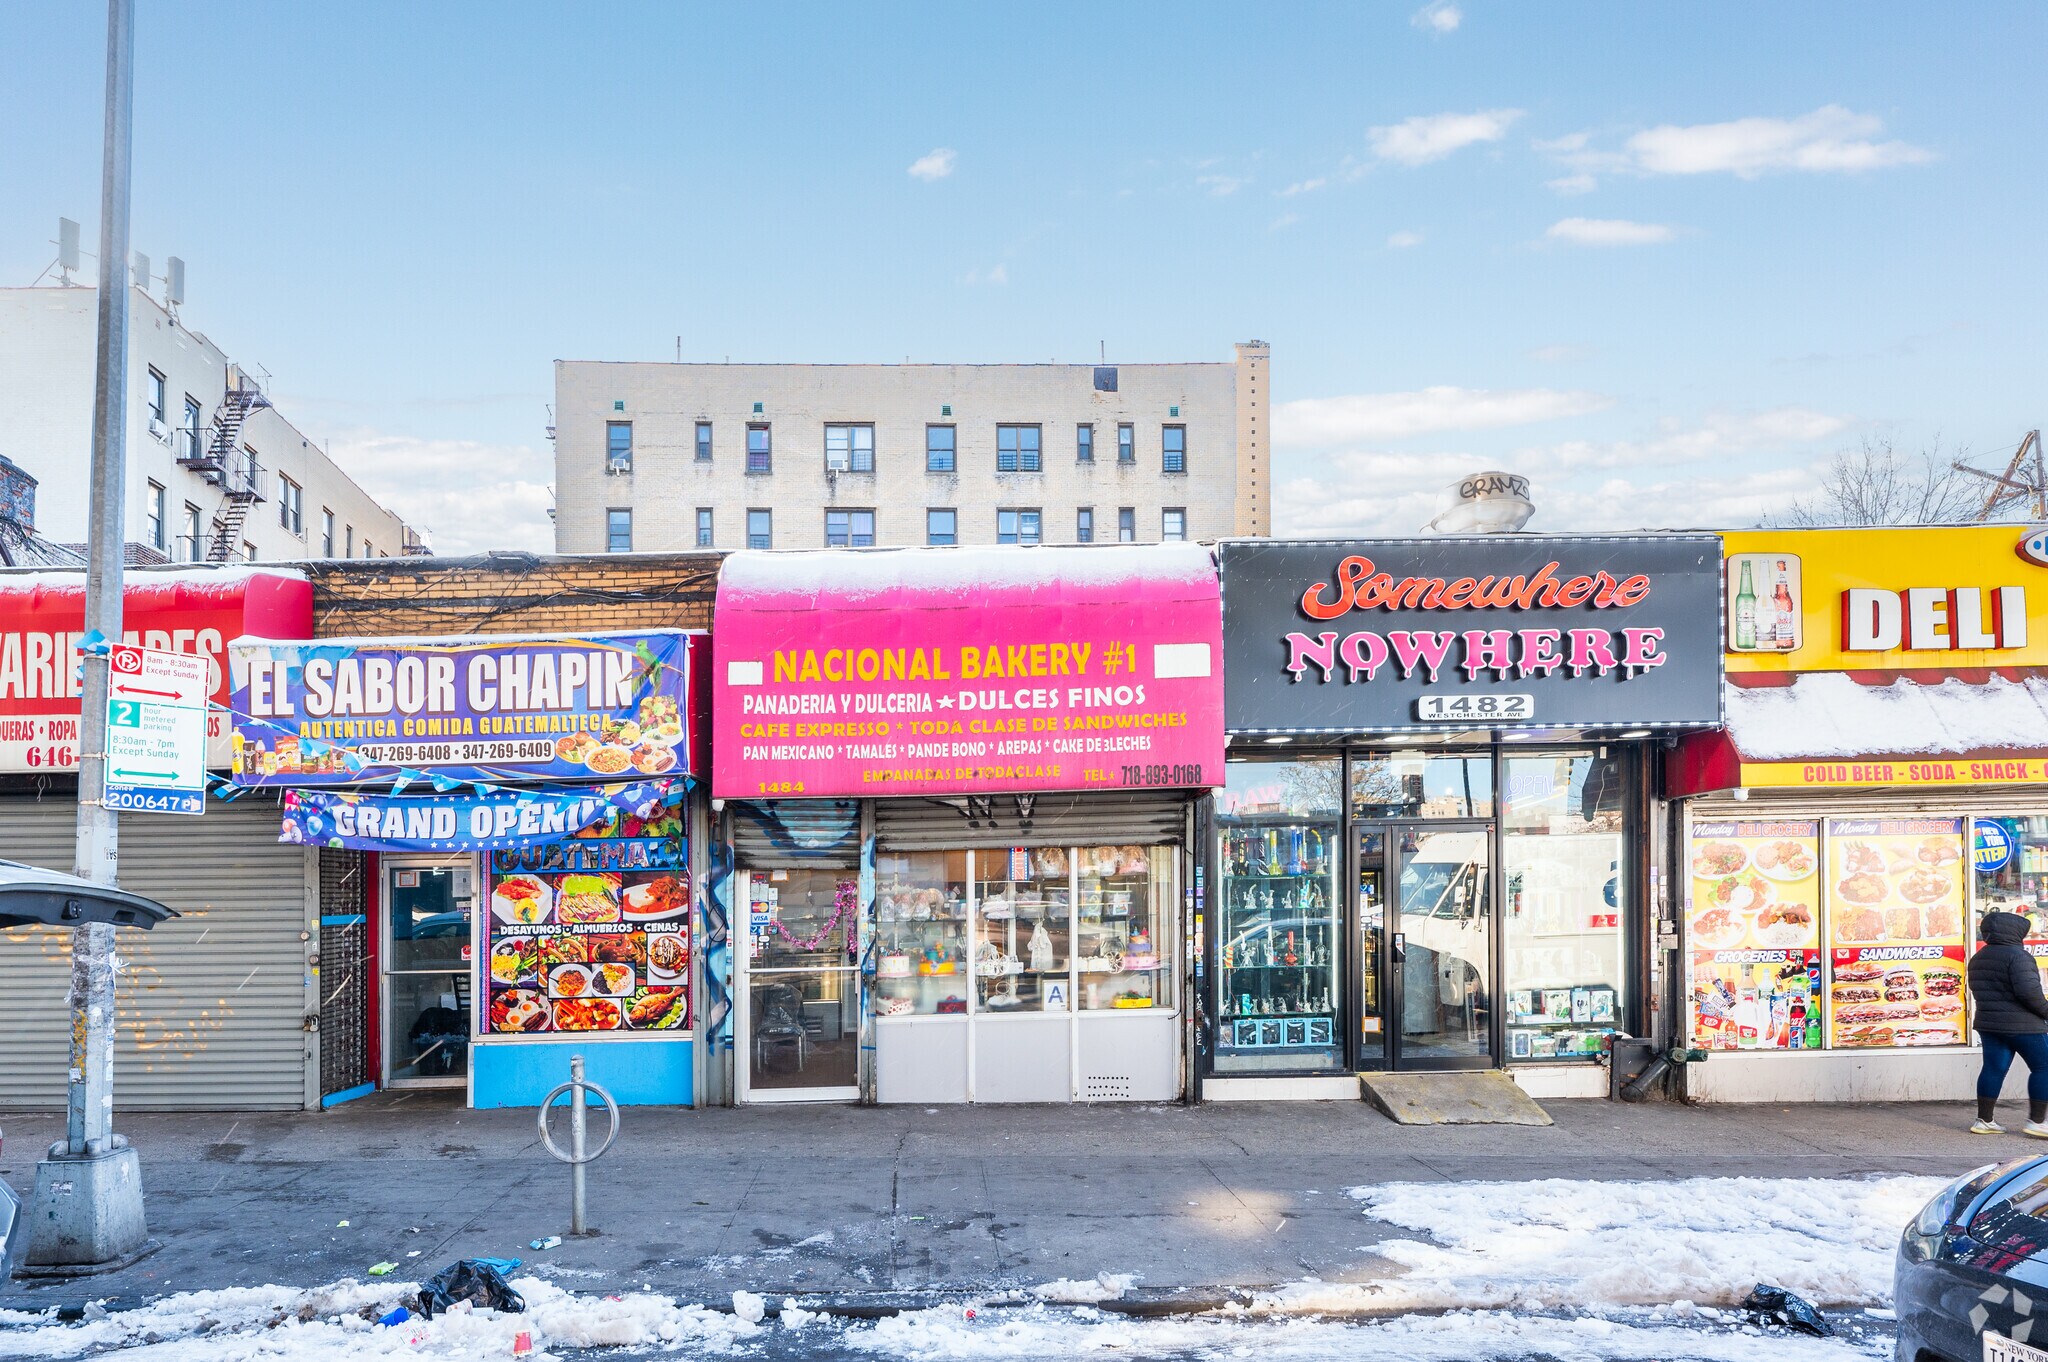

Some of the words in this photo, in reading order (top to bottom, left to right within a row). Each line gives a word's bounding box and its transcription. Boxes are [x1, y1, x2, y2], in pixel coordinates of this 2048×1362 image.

[1301, 555, 1651, 620] Somewhere
[1842, 586, 2028, 651] DELI
[146, 656, 163, 665] 8am
[170, 660, 198, 669] 8:30am
[774, 647, 950, 683] NACIONAL
[961, 642, 1093, 679] BAKERY
[1102, 640, 1136, 675] #1
[1284, 627, 1667, 682] NOWHERE
[146, 666, 171, 676] Except
[173, 670, 199, 680] Sunday
[248, 660, 295, 718] EL
[304, 654, 457, 717] SABOR
[468, 651, 633, 712] CHAPIN
[743, 695, 836, 715] PANADERIA
[841, 694, 850, 713] Y
[855, 693, 933, 713] DULCERIA
[959, 688, 1059, 711] DULCES
[1068, 685, 1146, 708] FINOS
[1428, 696, 1525, 713] 1482
[116, 703, 132, 725] 2
[144, 715, 176, 724] metered
[0, 720, 34, 741] UERAS
[49, 719, 77, 741] ROPA
[143, 723, 172, 732] parking
[300, 718, 397, 739] AUTENTICA
[403, 715, 475, 737] COMIDA
[479, 713, 612, 735] GUATEMALTECA
[740, 723, 789, 738] CAFE
[795, 721, 889, 737] EXPRESSO
[910, 720, 963, 735] TODA
[969, 718, 1027, 734] CLASE
[1032, 717, 1058, 731] DE
[1063, 712, 1187, 730] SANDWICHES
[112, 735, 147, 746] 8:30am
[157, 739, 175, 749] 7pm
[463, 741, 552, 759] 347-269-6409
[743, 746, 769, 760] PAN
[771, 745, 834, 760] MEXICANO
[846, 744, 897, 759] TAMALES
[952, 741, 987, 757] BONO
[997, 739, 1042, 756] AREPAS
[1053, 738, 1083, 754] CAKE
[1086, 737, 1101, 752] DE
[112, 745, 144, 757] Except
[147, 748, 179, 760] Sunday
[864, 768, 951, 783] EMPANADAS
[955, 767, 973, 780] DE
[1121, 764, 1202, 785] 718-893-0168
[1803, 765, 1847, 782] COLD
[1852, 764, 1893, 781] BEER
[1909, 763, 1956, 780] SODA
[1970, 762, 2029, 780] SNACK
[758, 782, 806, 794] 1484
[1509, 774, 1555, 796] OPEN
[108, 792, 180, 811] 200647
[331, 804, 457, 840] GRAND
[1692, 823, 1735, 836] Monday
[1737, 823, 1760, 836] DELI
[1762, 823, 1813, 837] GROCERY
[1834, 822, 1878, 835] Monday
[1880, 821, 1905, 834] DELI
[1905, 820, 1955, 834] GROCERY
[1982, 826, 1999, 836] NEW
[500, 924, 563, 936] DESAYUNOS
[572, 922, 633, 935] ALMUERZOS
[643, 922, 680, 933] CENAS
[1713, 950, 1787, 963] GROCERIES
[1858, 946, 1944, 961] SANDWICHES
[1048, 985, 1063, 1003] A
[2004, 1342, 2025, 1356] NEW
